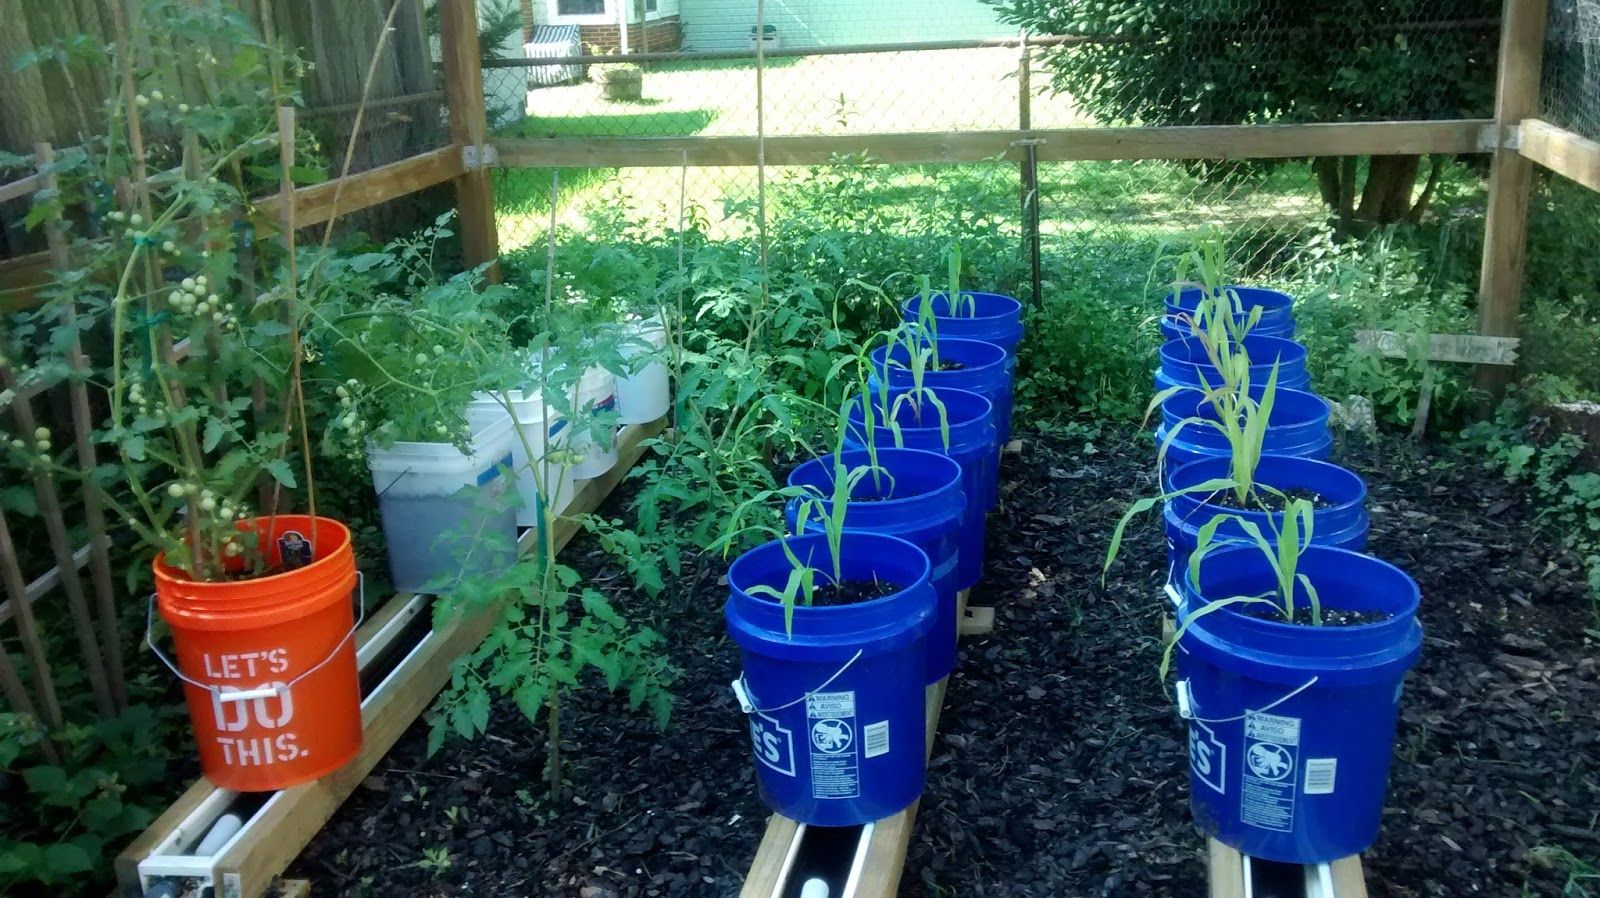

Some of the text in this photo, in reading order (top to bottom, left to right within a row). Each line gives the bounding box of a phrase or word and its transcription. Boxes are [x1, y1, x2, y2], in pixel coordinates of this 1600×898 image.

[203, 648, 288, 679] LET'S
[210, 681, 294, 732] DO
[216, 733, 309, 767] THIS.
